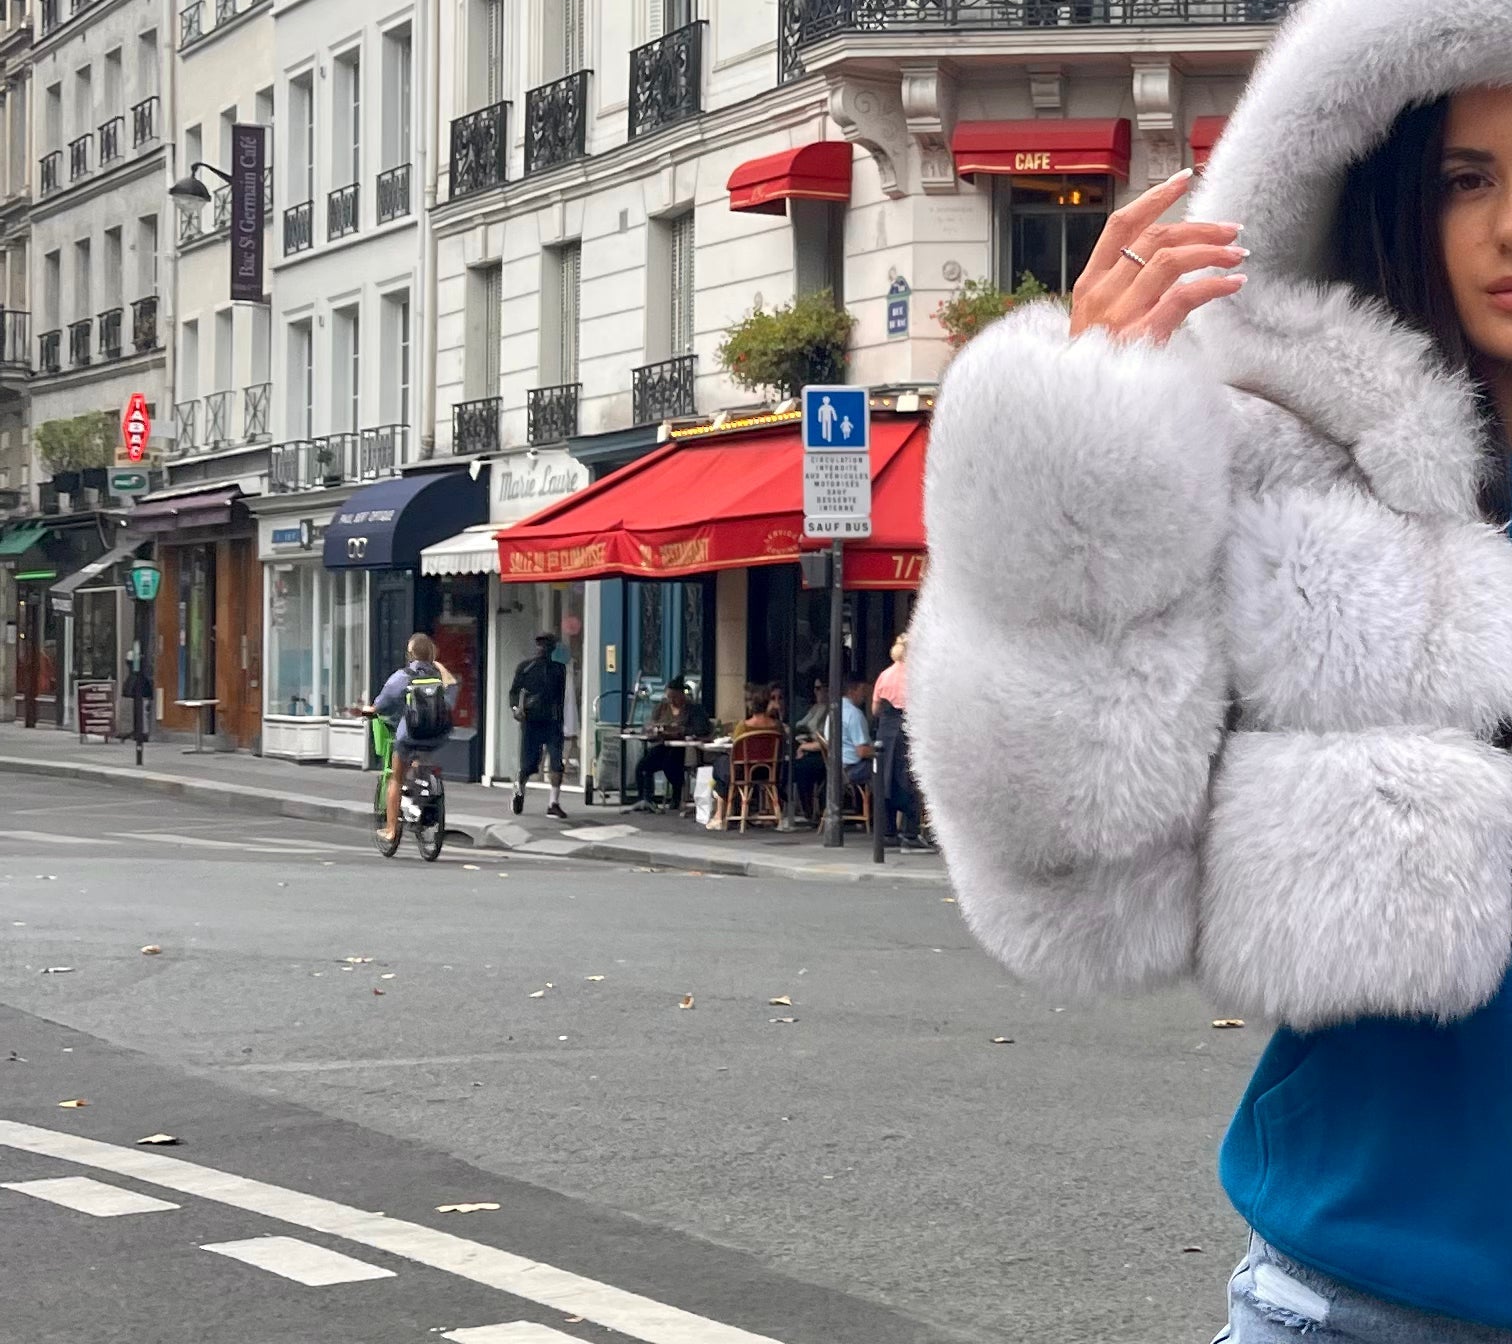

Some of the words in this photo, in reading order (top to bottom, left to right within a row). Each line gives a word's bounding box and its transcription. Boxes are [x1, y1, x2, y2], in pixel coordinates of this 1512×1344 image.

[239, 135, 257, 168] Café
[1014, 152, 1051, 171] CAFE
[239, 172, 257, 233] Germain
[238, 252, 255, 277] Bac
[127, 398, 145, 457] TABAC
[500, 469, 536, 502] Marie
[537, 465, 579, 498] Laure
[808, 522, 840, 532] SAUF
[845, 522, 869, 532] BUS
